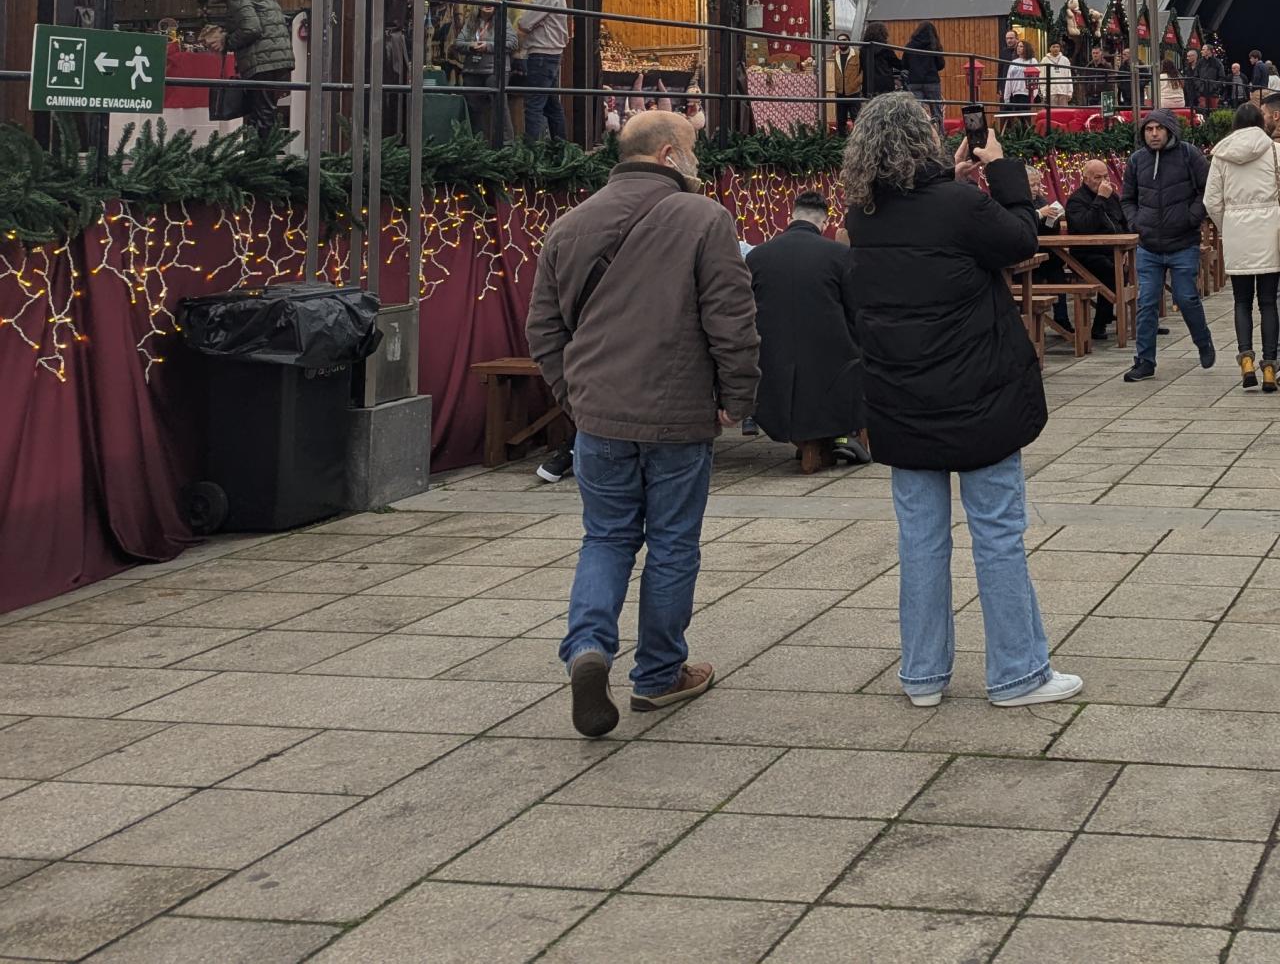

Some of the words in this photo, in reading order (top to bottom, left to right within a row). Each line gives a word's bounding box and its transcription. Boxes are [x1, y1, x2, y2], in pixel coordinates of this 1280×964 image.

[46, 95, 88, 107] CAMINHO
[89, 97, 102, 108] DE
[102, 97, 153, 111] EVACUAÇÃO
